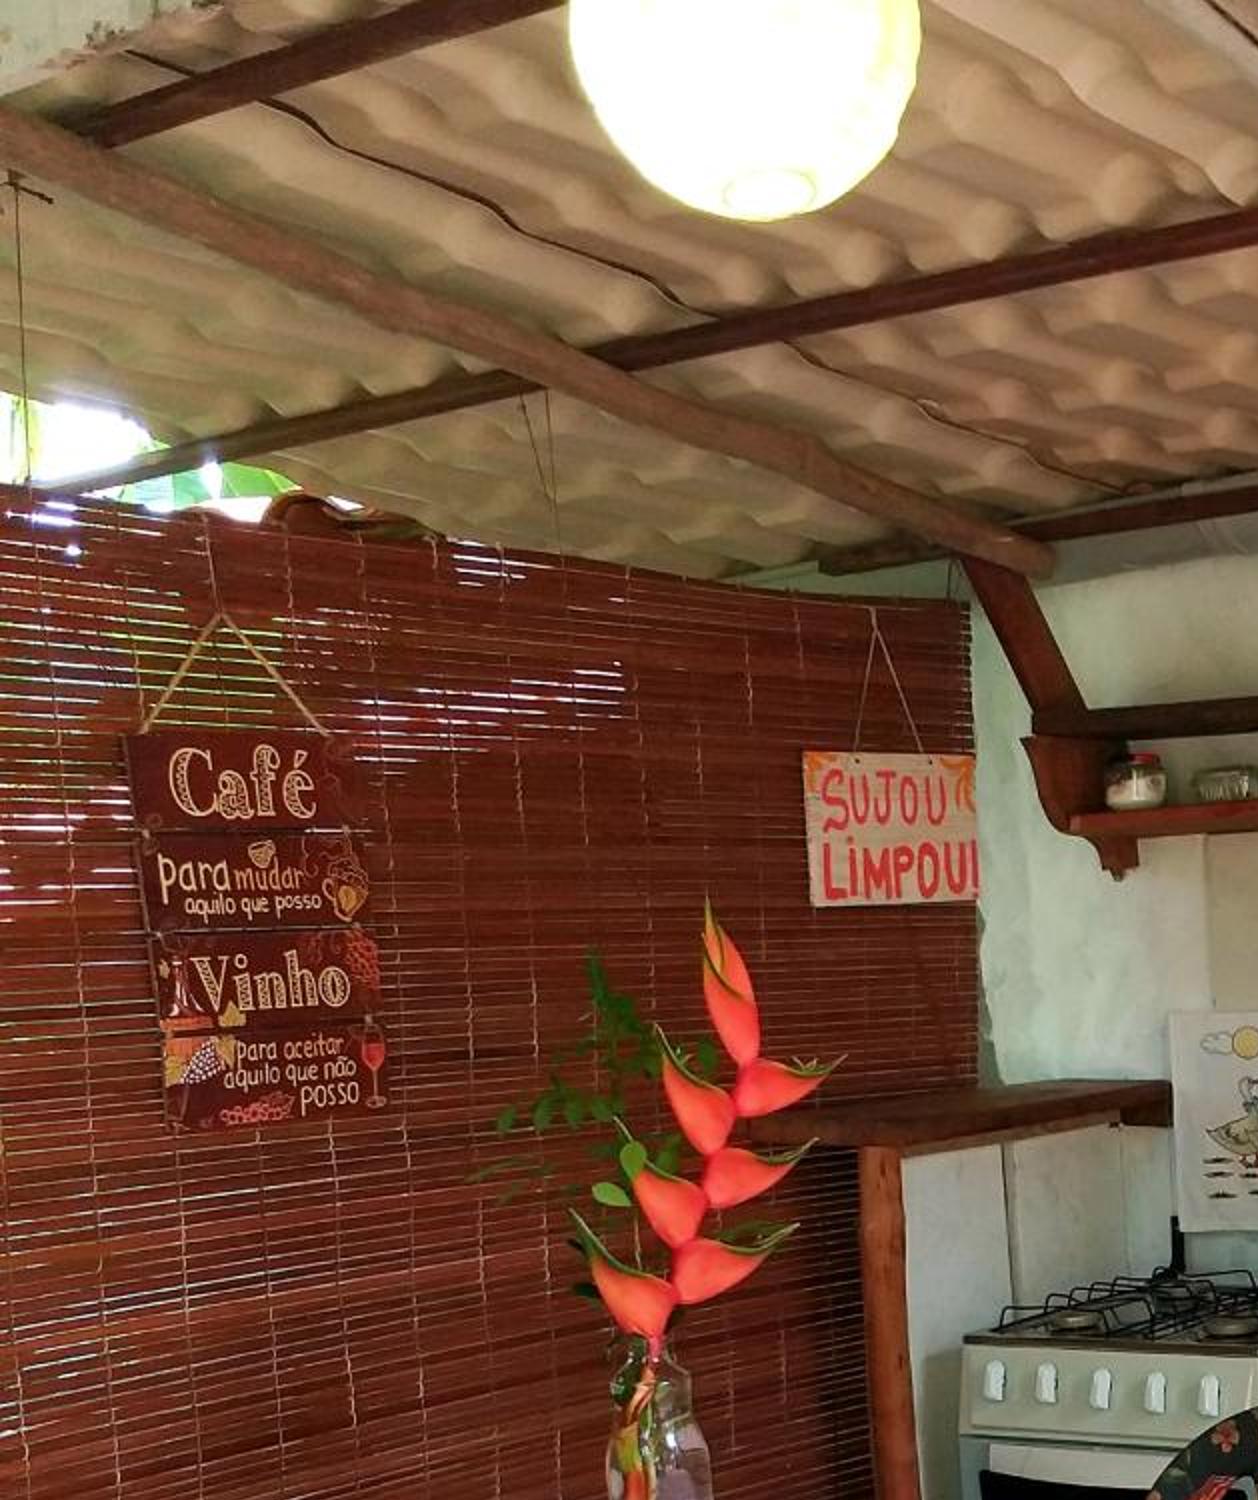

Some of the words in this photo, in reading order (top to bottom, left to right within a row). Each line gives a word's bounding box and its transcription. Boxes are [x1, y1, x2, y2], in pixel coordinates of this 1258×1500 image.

[169, 743, 317, 819] Café
[821, 768, 947, 832] SUJOU
[157, 852, 231, 905] para
[234, 856, 305, 891] mudar
[185, 892, 236, 924] aquilo
[241, 897, 270, 921] que
[275, 894, 322, 918] posso
[190, 949, 350, 1012] Vinho
[237, 1041, 277, 1068] para
[283, 1032, 344, 1059] aceitar
[224, 1064, 280, 1093] aquilo
[285, 1064, 318, 1087] que
[324, 1056, 357, 1079] não
[301, 1082, 359, 1117] posso
